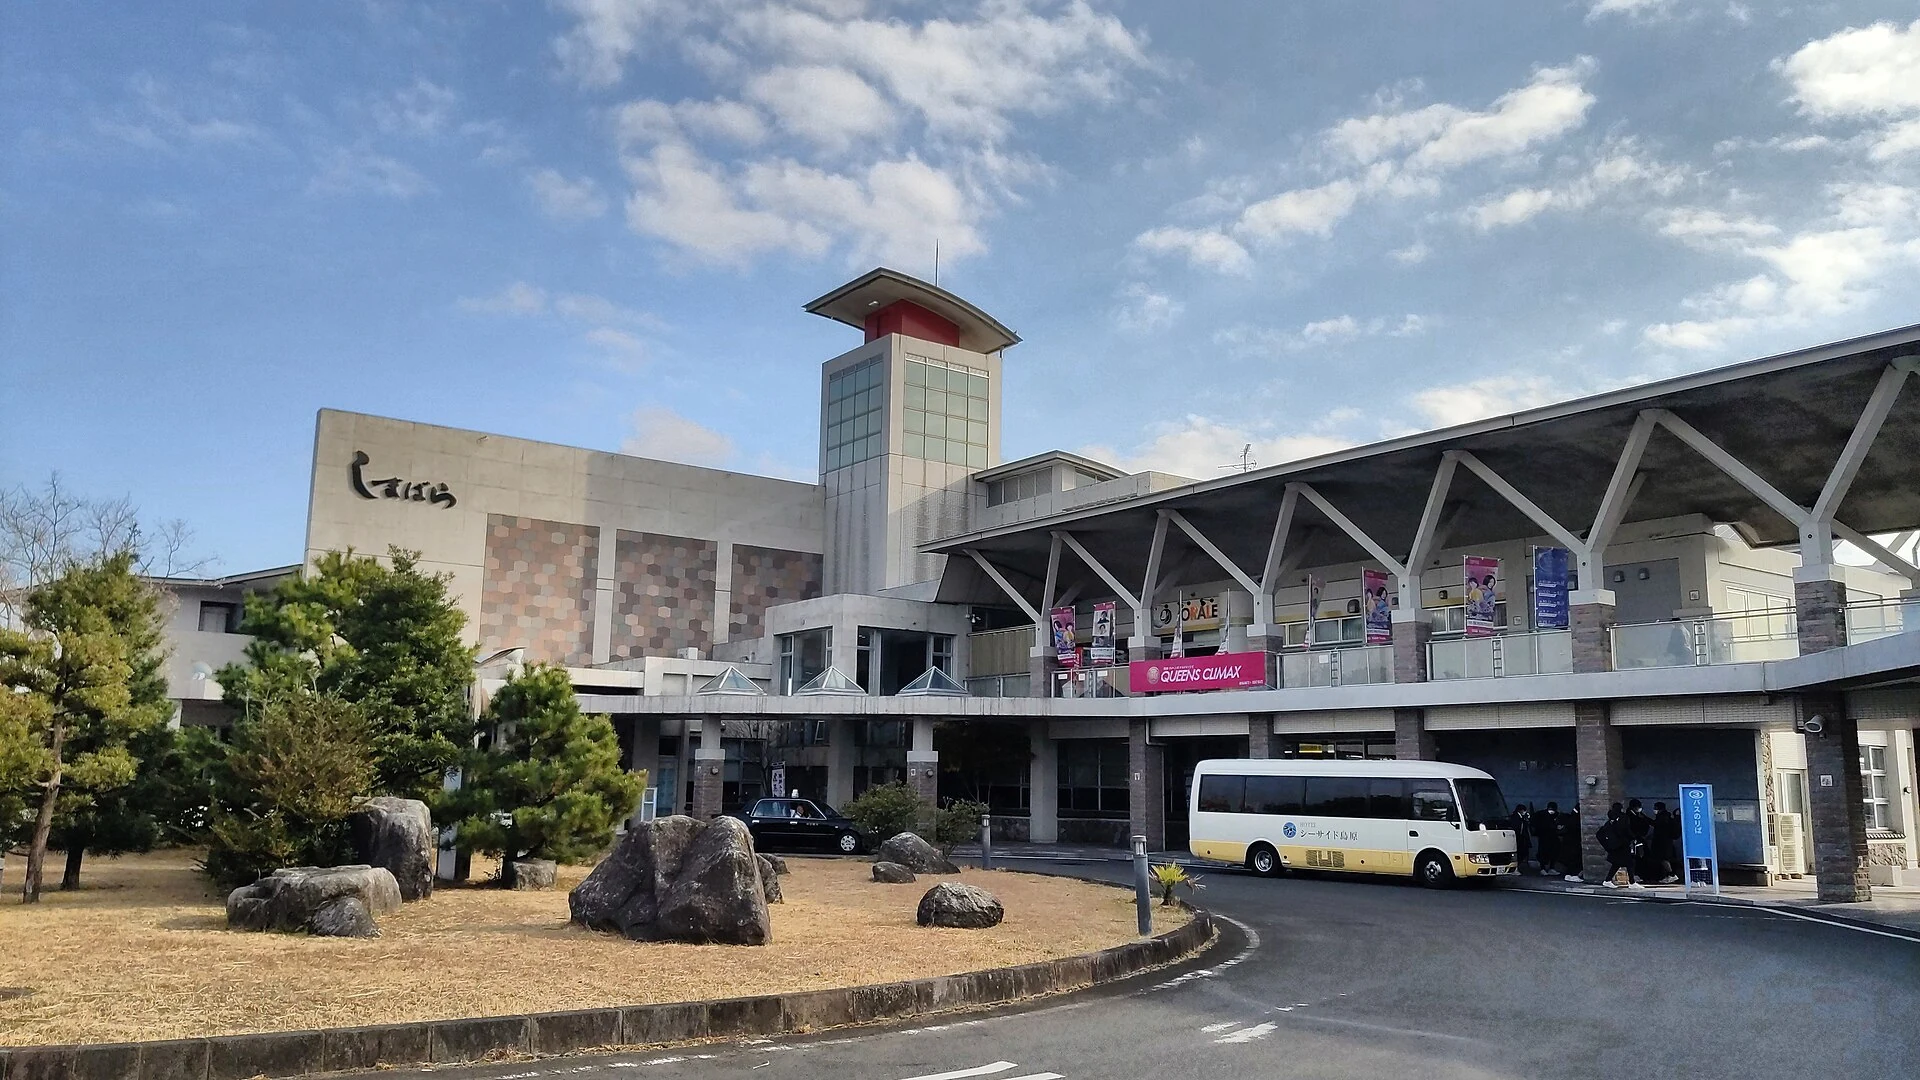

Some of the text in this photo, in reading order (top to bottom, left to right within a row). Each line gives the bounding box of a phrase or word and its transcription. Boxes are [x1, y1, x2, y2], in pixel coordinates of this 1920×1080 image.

[351, 450, 457, 509] しまばら
[1160, 665, 1242, 683] QUEENS CLIMAX
[1693, 799, 1703, 834] バスのりば
[1300, 829, 1358, 841] シーサイド島原
